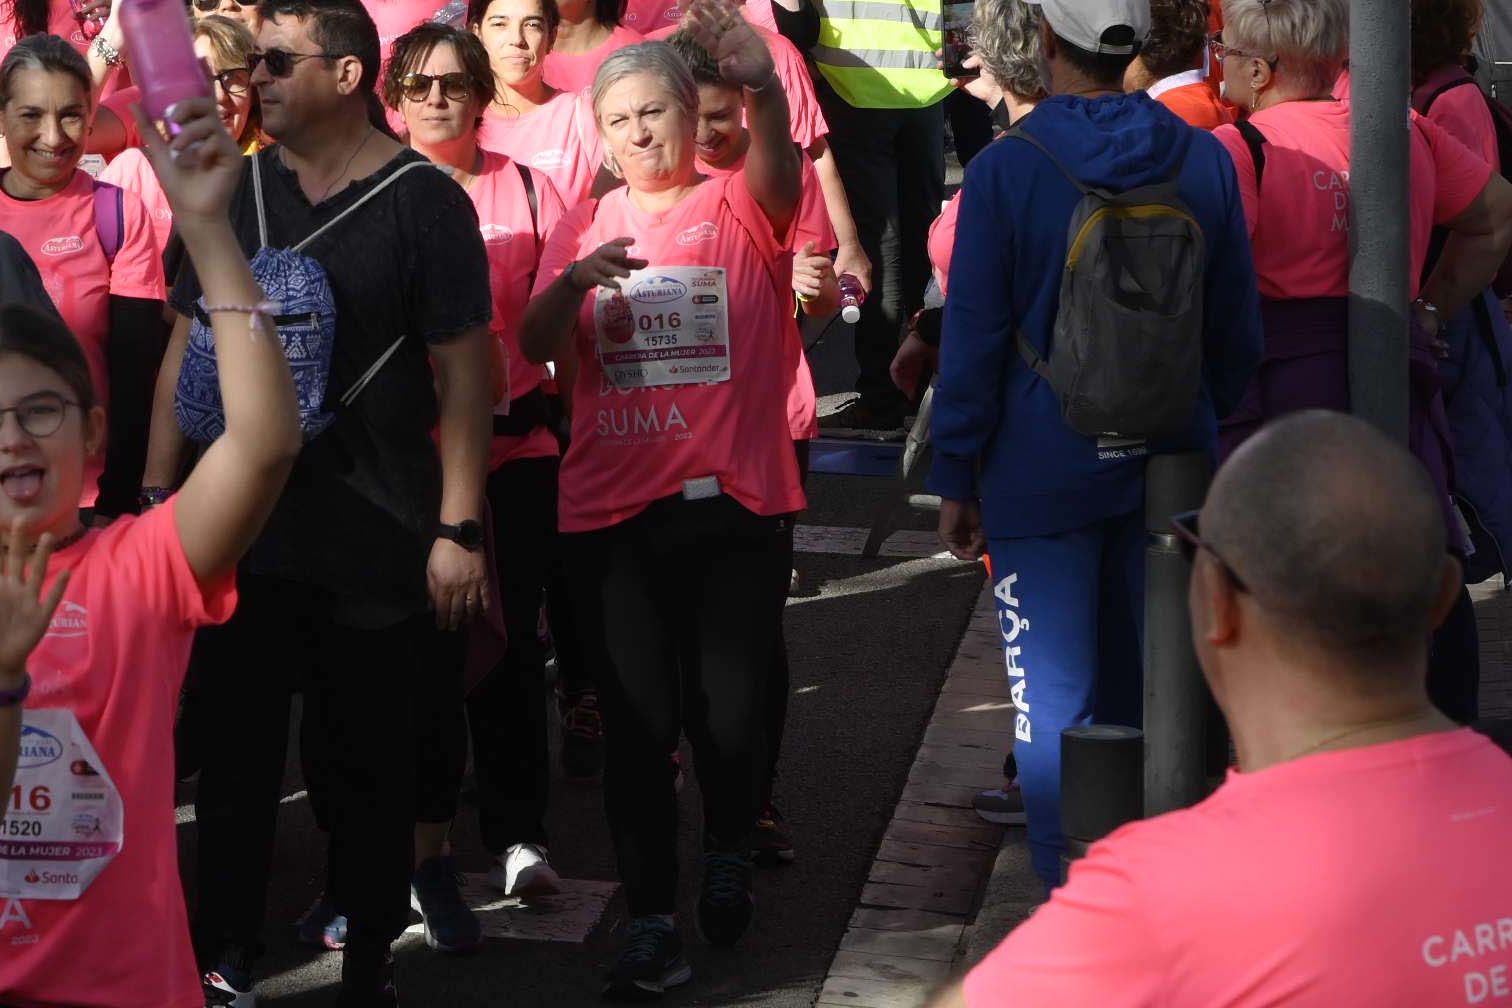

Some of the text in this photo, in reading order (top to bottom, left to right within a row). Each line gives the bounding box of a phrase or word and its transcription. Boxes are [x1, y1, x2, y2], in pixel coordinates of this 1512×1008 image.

[635, 287, 683, 299] ASTURIANA
[639, 312, 682, 331] 016
[644, 334, 678, 347] 15735
[660, 350, 670, 358] LA
[679, 364, 720, 374] Santander
[598, 402, 688, 436] SUMA
[1098, 450, 1126, 460] SINCE
[11, 845, 27, 856] LA
[29, 846, 71, 857] MUJER
